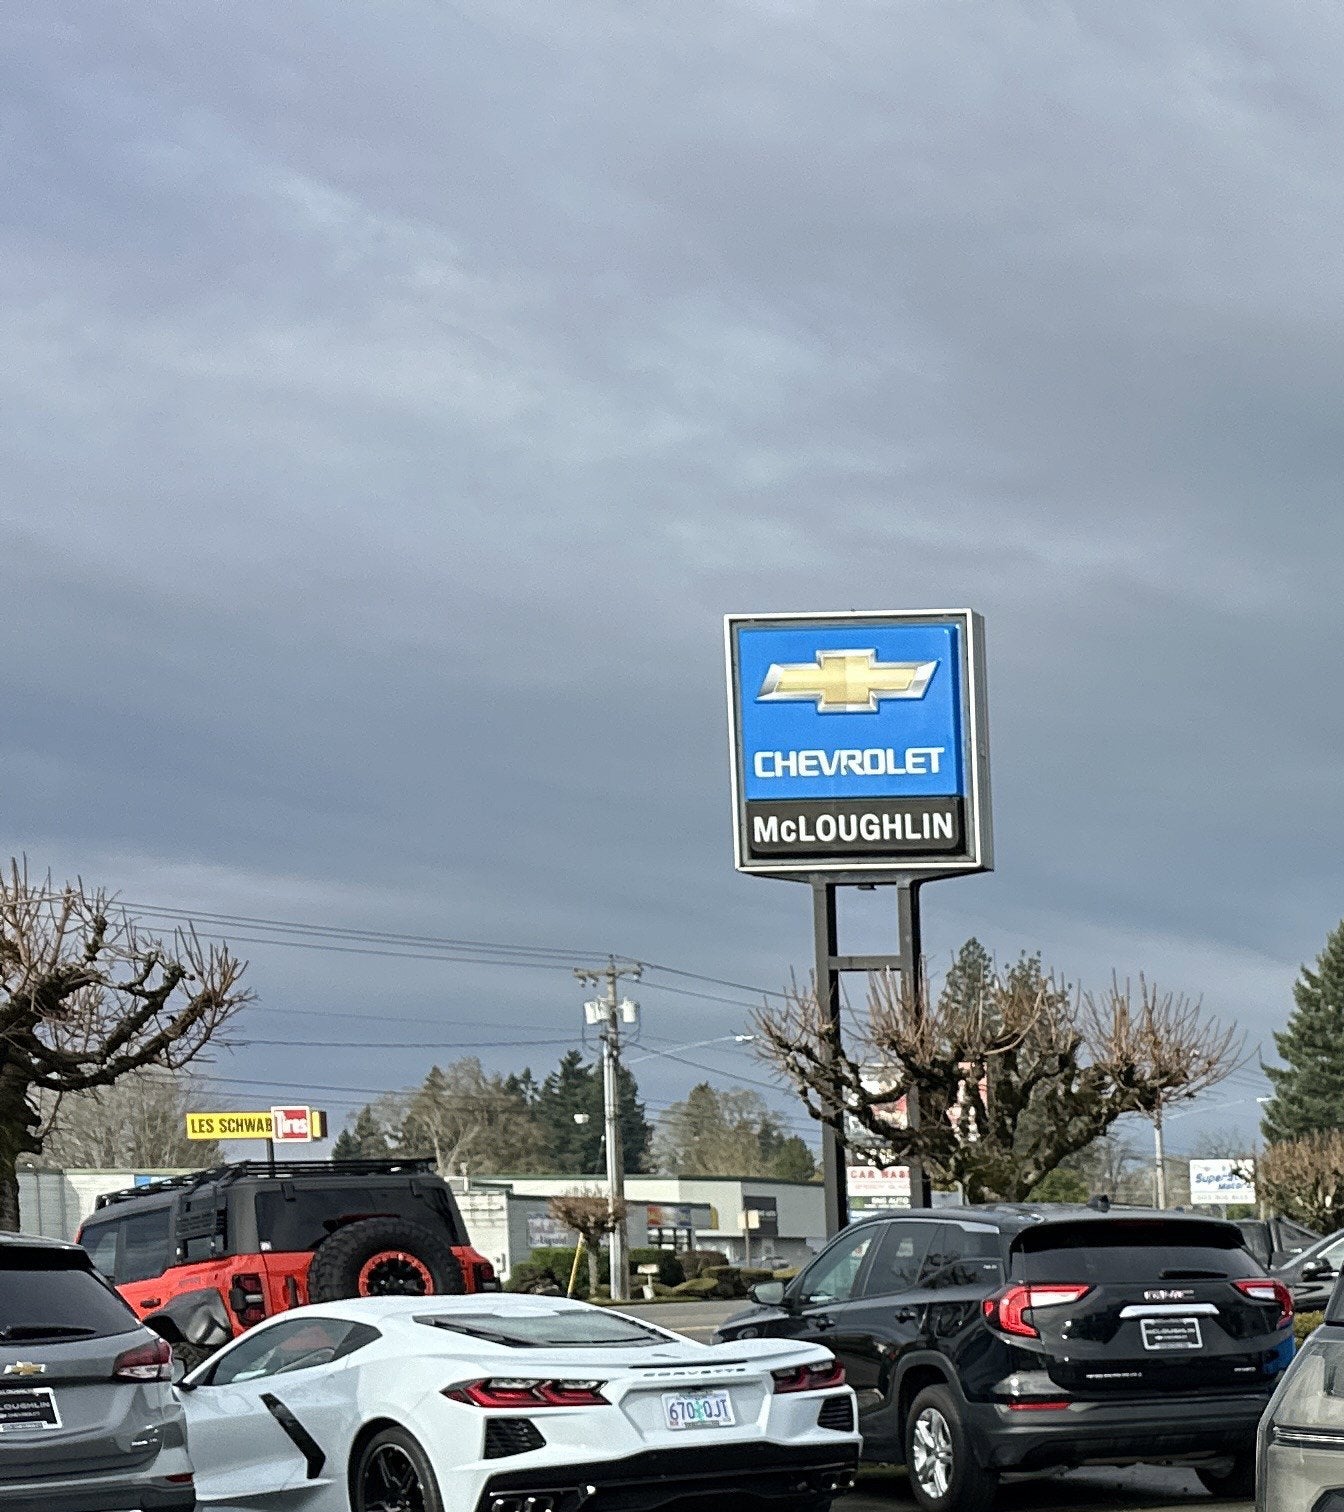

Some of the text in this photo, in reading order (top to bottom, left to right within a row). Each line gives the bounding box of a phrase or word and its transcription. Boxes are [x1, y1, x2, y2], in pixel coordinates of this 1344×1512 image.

[754, 747, 945, 778] CHEVROLET
[753, 812, 953, 843] McLOUGHLIN
[191, 1117, 273, 1133] LES SCHWAB
[851, 1170, 875, 1178] CAR
[643, 1367, 746, 1378] CORVETTE
[669, 1401, 696, 1421] 670
